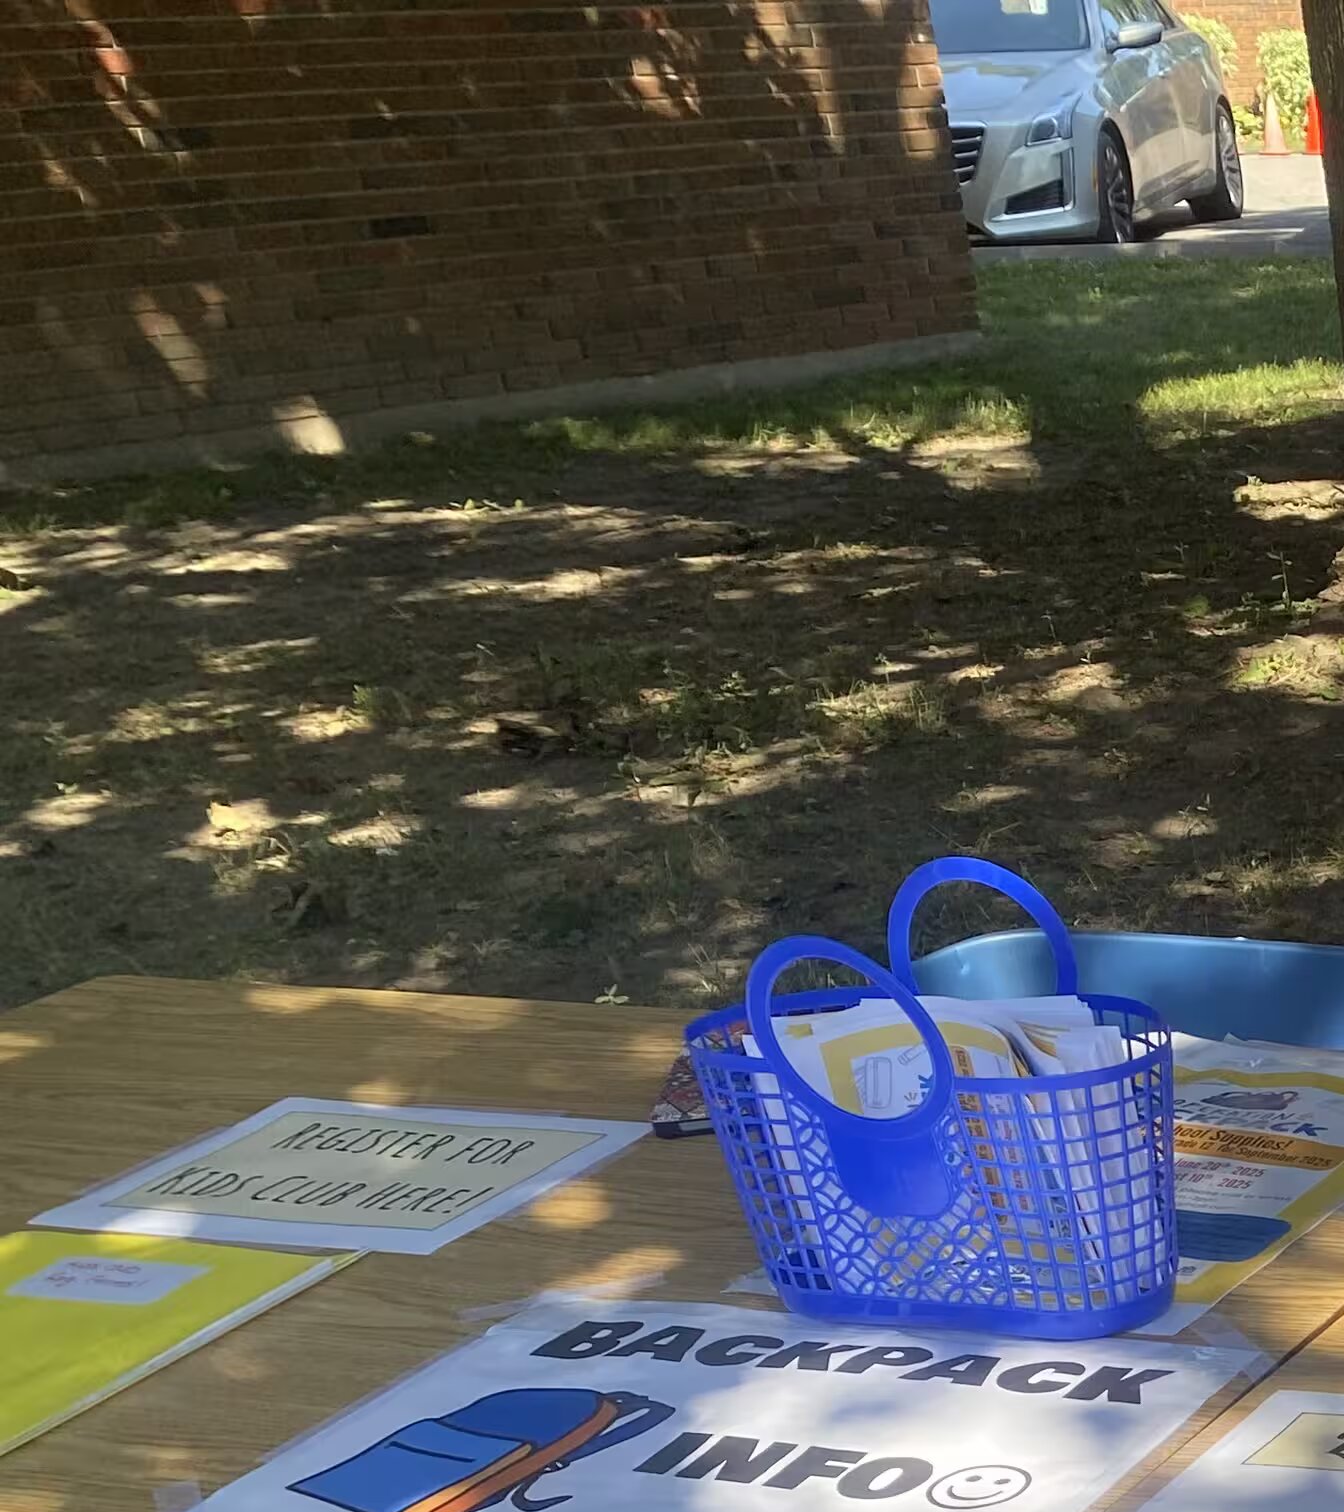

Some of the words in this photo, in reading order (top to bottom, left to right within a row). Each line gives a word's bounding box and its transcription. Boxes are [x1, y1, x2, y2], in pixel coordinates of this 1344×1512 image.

[270, 1122, 454, 1161] REGISTER
[446, 1136, 535, 1166] FOR
[1174, 1124, 1209, 1141] hool
[1209, 1129, 1294, 1151] Supplies!
[1235, 1146, 1298, 1164] September
[1217, 1177, 1253, 1190] 2025
[1232, 1165, 1268, 1178] 2025
[147, 1166, 264, 1199] KIDS
[251, 1175, 366, 1208] CLUB
[355, 1183, 495, 1214] HERE!
[531, 1321, 1173, 1404] BACKPACK
[633, 1431, 935, 1500] INFO
